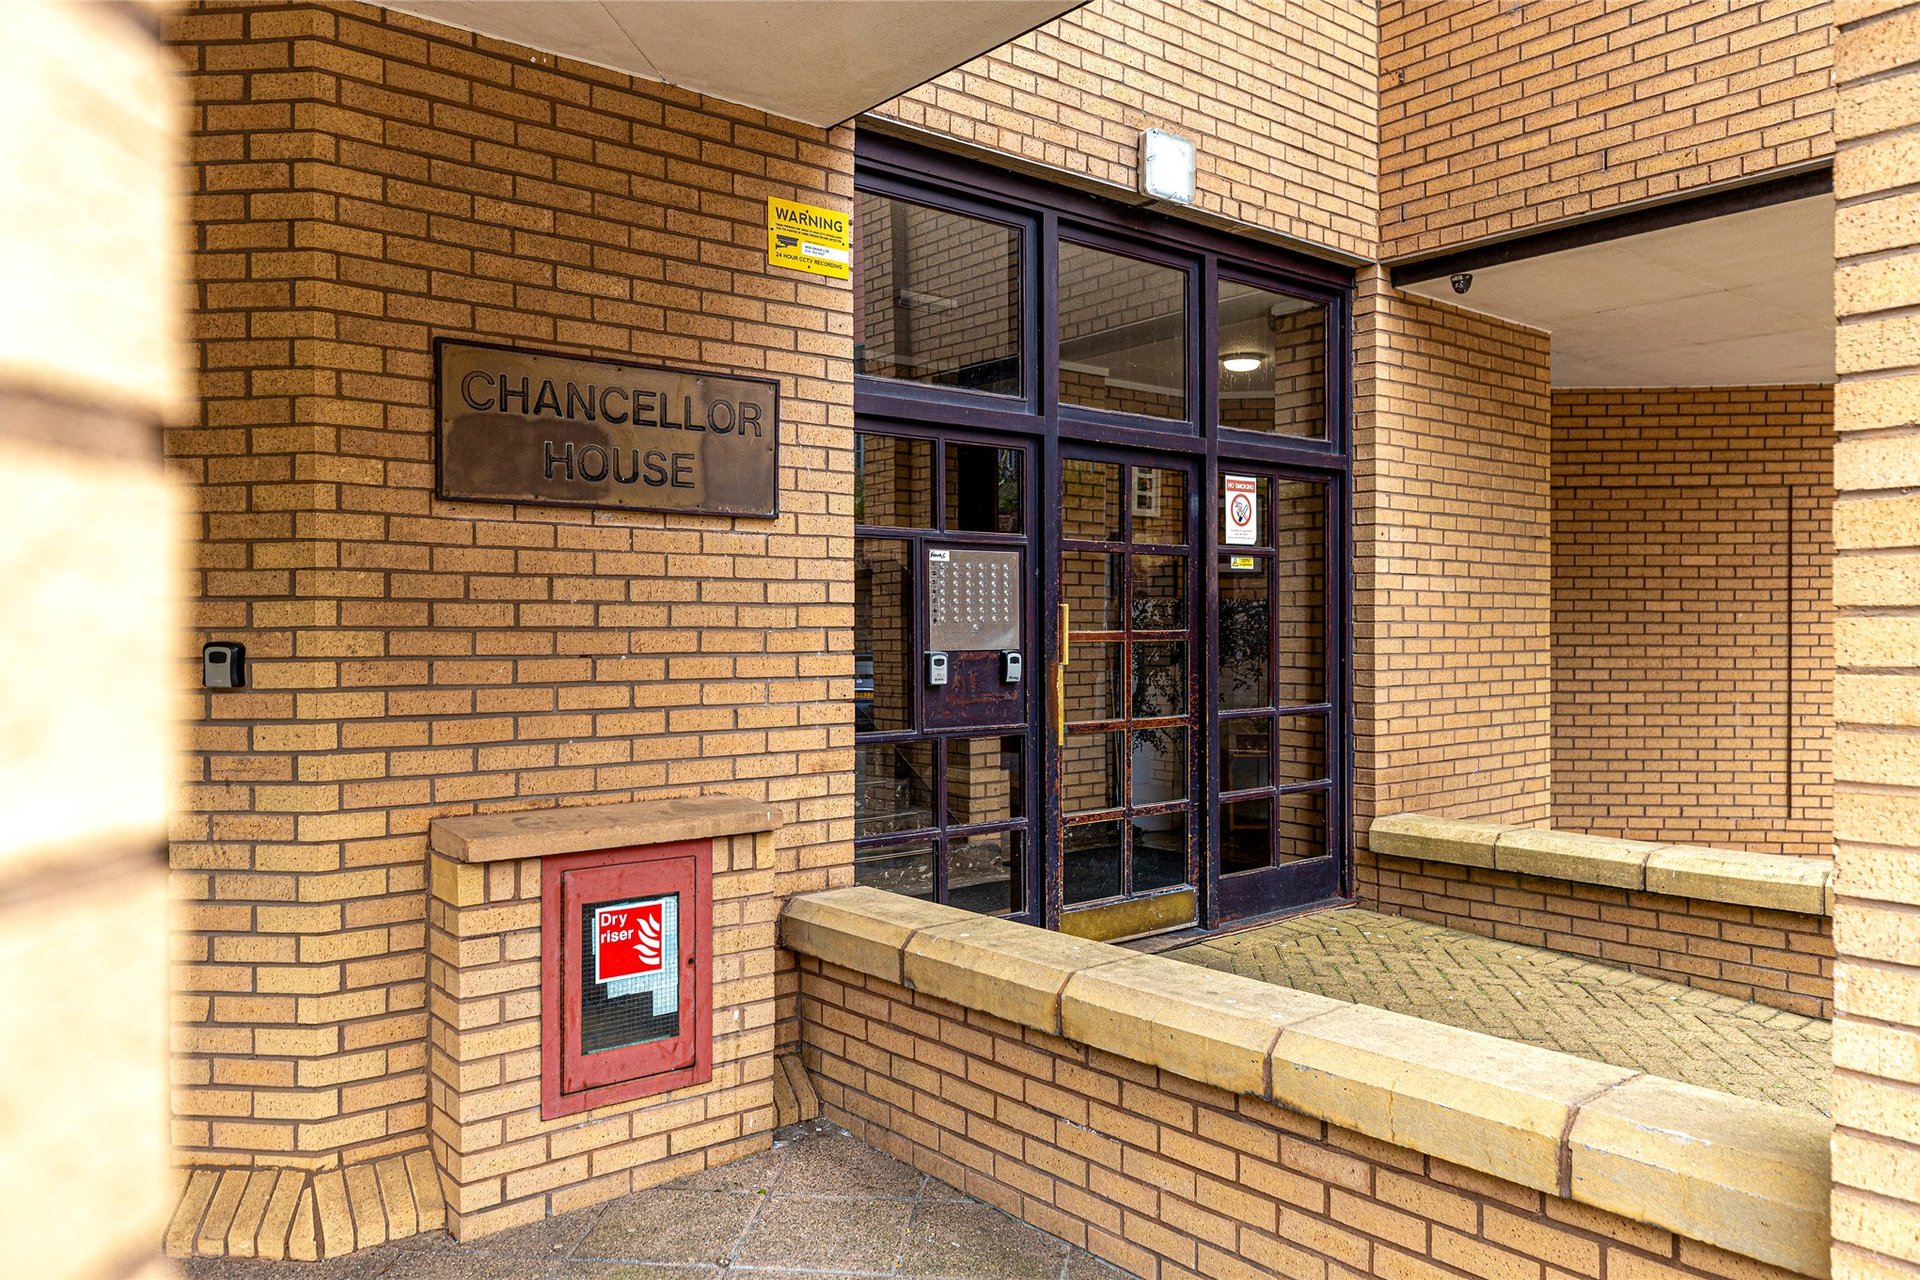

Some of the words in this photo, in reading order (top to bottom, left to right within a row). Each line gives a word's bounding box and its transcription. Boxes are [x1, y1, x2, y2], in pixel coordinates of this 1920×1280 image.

[775, 206, 843, 233] WARNING
[799, 256, 813, 264] CCTV
[814, 259, 843, 270] RECORDING
[461, 370, 763, 438] CHANCELLOR
[544, 440, 695, 489] HOUSE
[601, 913, 628, 928] Dry
[600, 929, 634, 944] riser
